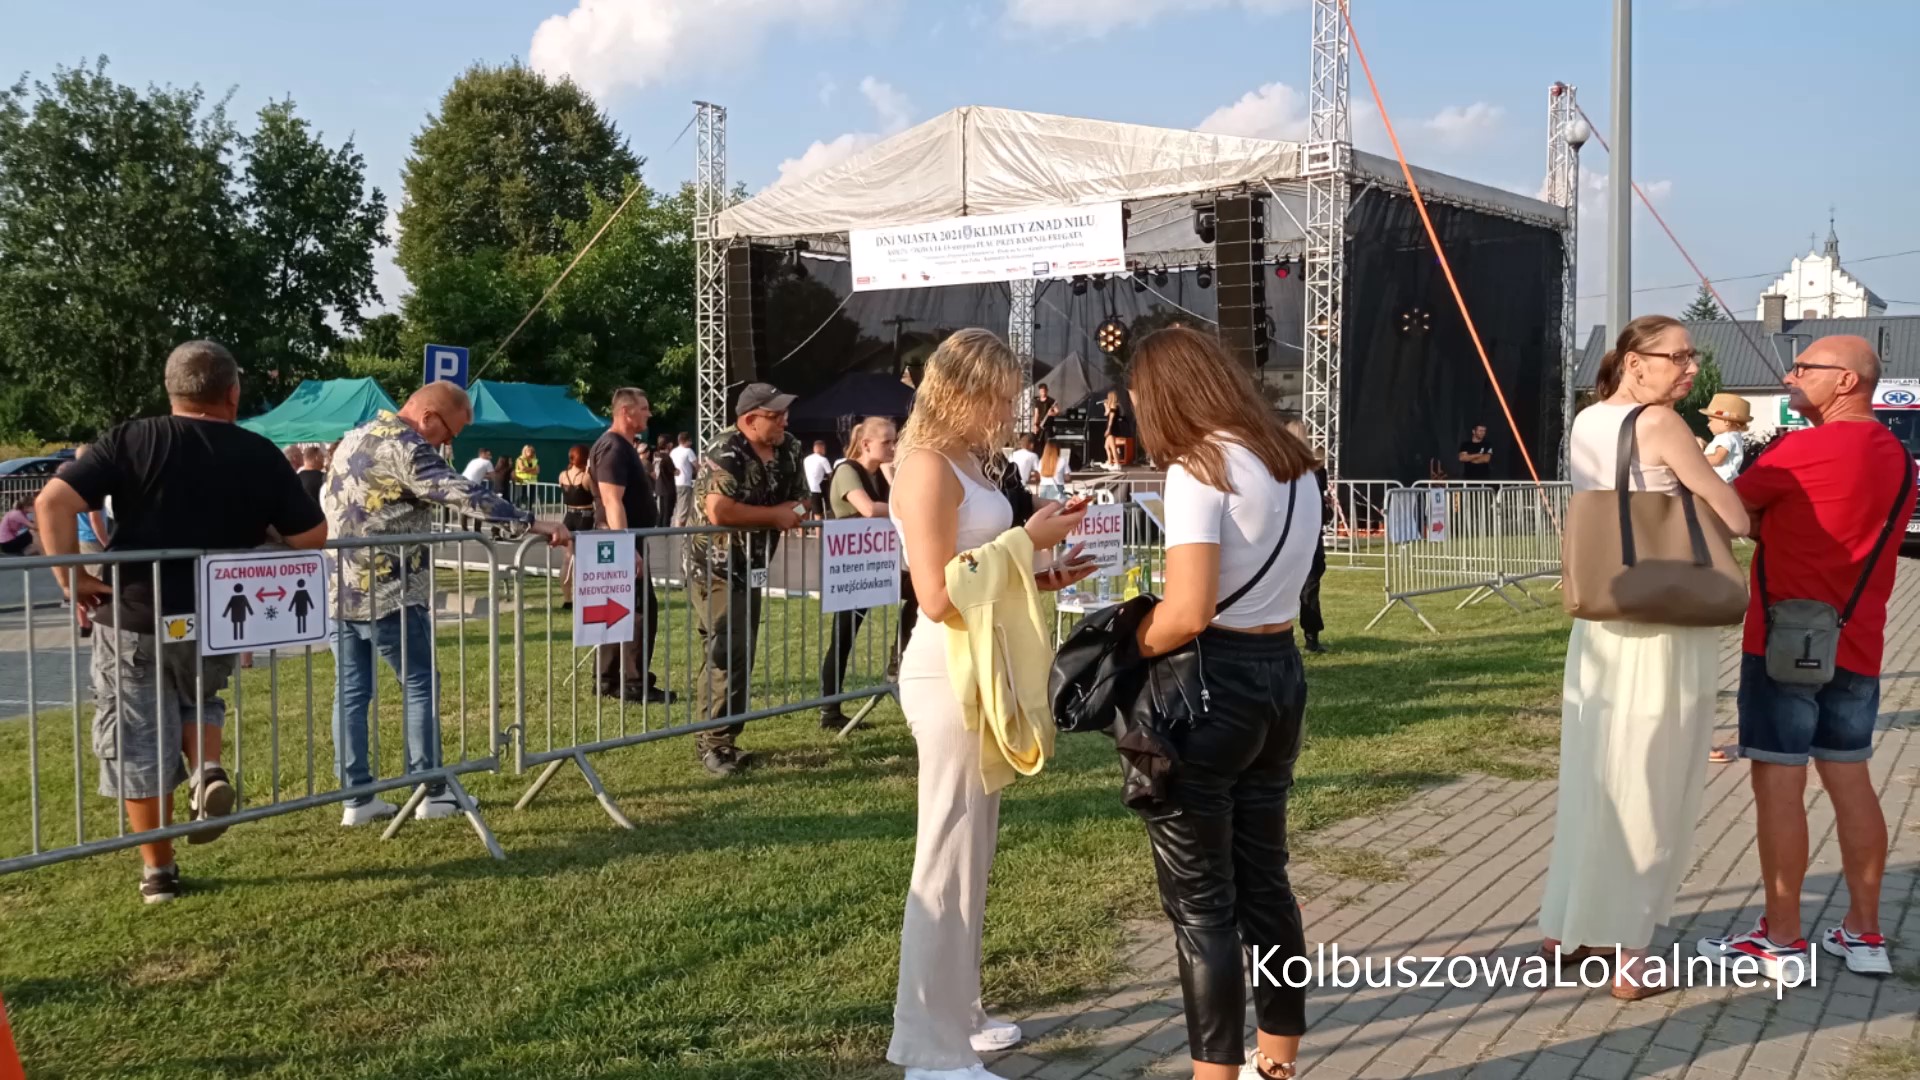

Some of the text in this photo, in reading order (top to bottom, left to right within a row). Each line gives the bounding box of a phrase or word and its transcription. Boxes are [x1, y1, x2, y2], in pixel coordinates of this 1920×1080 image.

[875, 214, 1095, 247] DNI MIASTA 2021 KLIMATY ZNAD NILU
[434, 350, 459, 382] P
[827, 526, 896, 557] WEJŚCIE
[214, 562, 318, 580] ZACHOWAJ ODSTĘP
[583, 570, 628, 581] DO PUNKTU
[829, 559, 896, 575] na teren imprezy
[578, 584, 632, 596] MEDYCZNEGO
[830, 576, 893, 595] z wejściówkami
